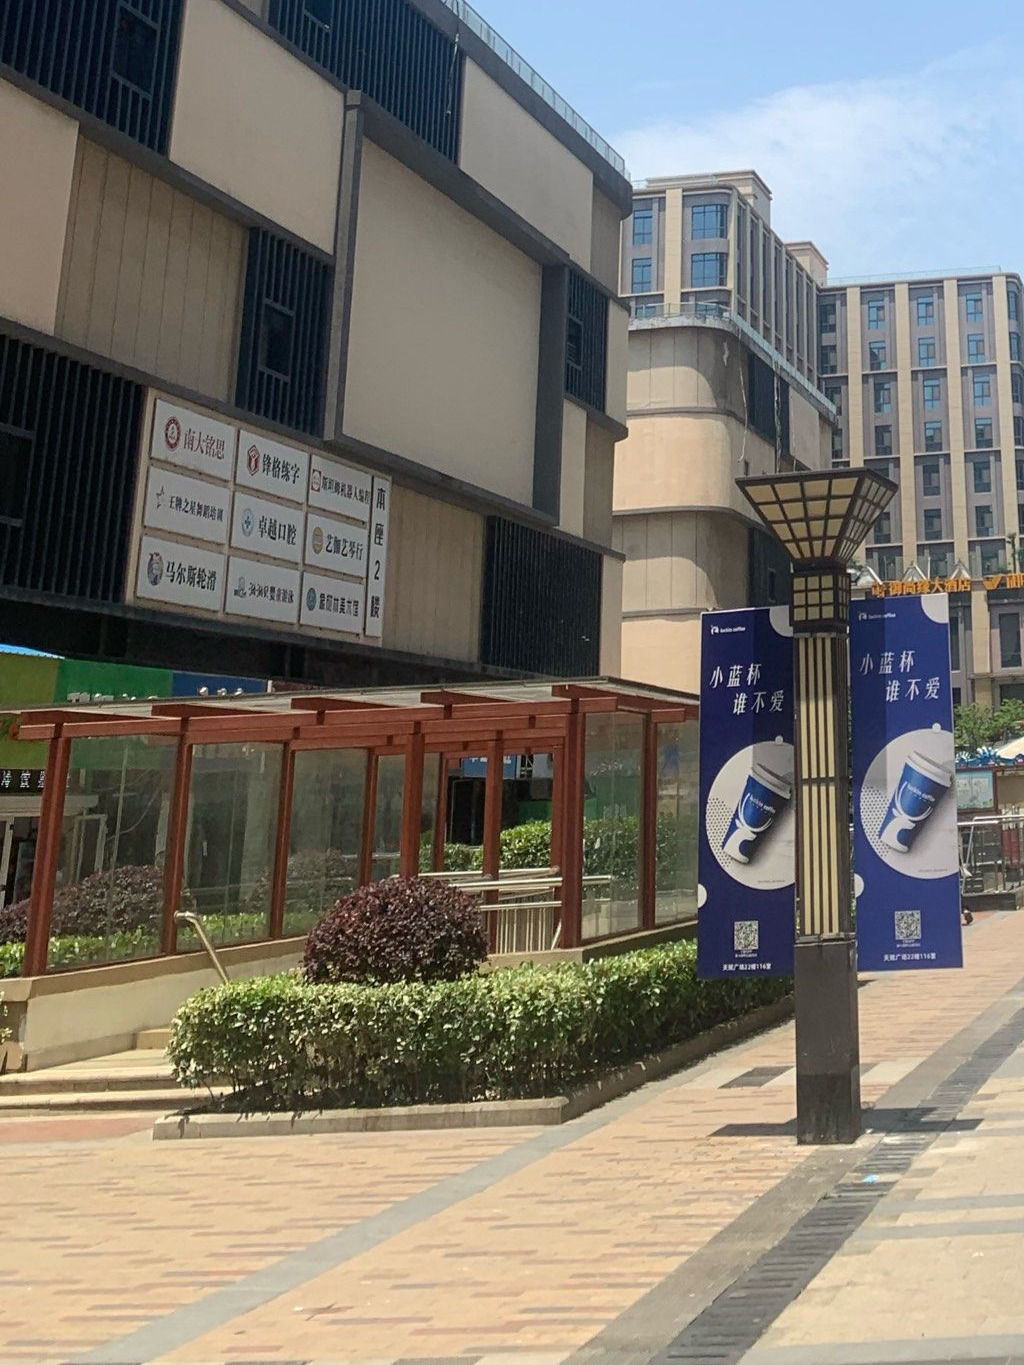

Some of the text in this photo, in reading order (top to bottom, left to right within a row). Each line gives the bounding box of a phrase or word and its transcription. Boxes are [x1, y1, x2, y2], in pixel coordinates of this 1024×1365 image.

[258, 516, 297, 546] 卓越口腔
[709, 663, 762, 688] 小蓝杯
[860, 650, 915, 676] 小蓝杯
[733, 689, 784, 715] 谁不爱
[885, 677, 940, 703] 谁不爱
